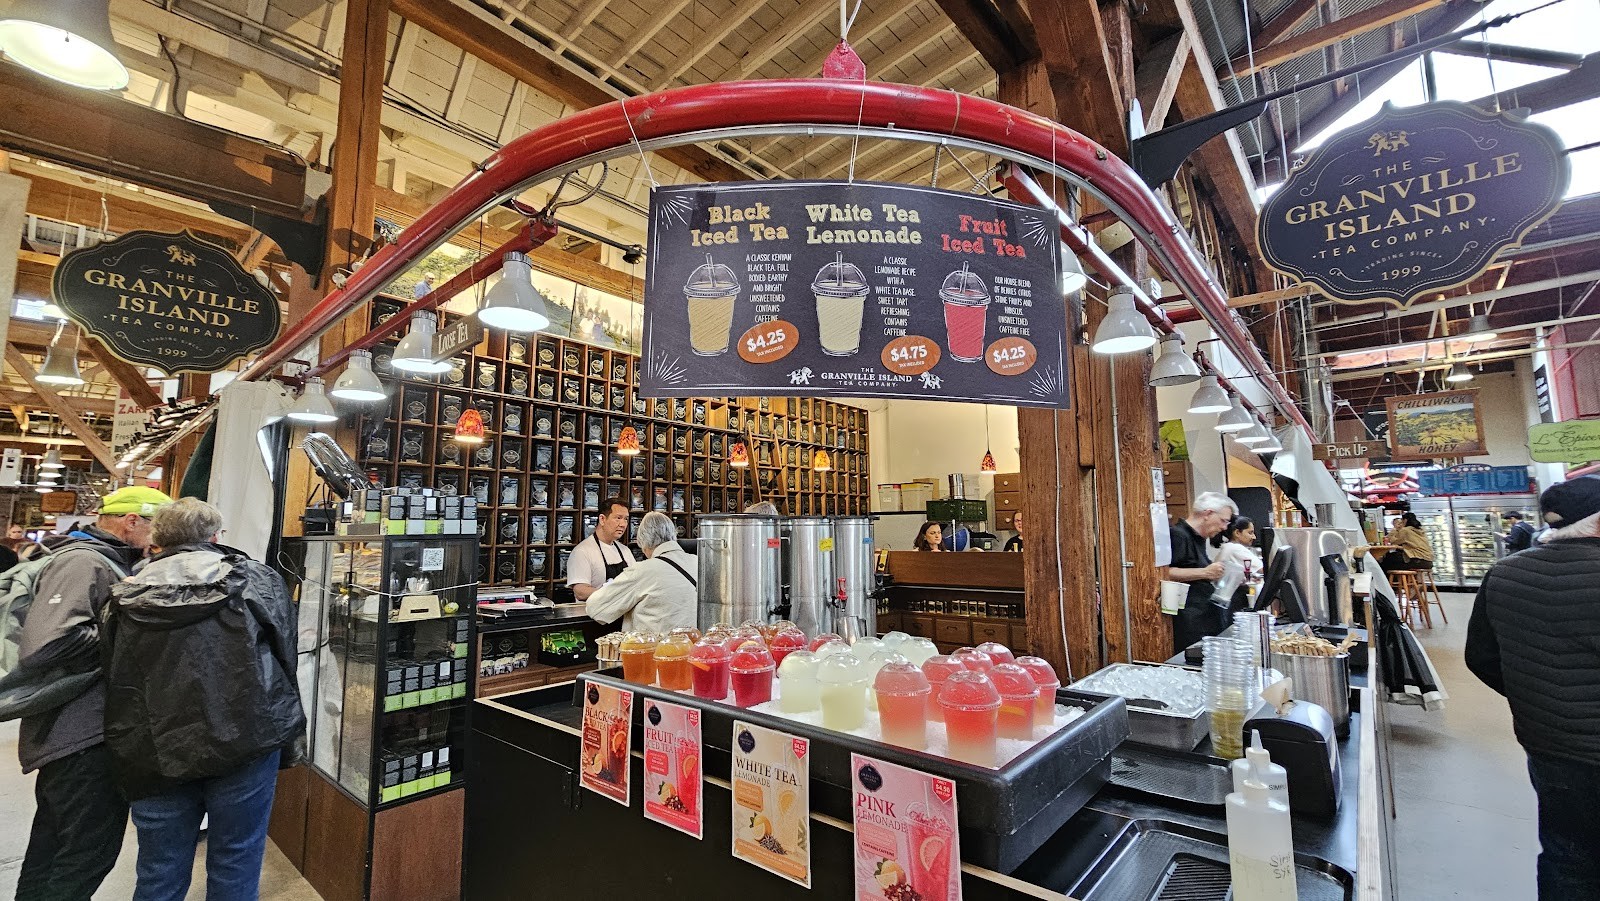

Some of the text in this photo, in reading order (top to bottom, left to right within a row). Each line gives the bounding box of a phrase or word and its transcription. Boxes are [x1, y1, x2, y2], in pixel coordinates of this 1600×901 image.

[1373, 160, 1413, 178] THE
[1285, 152, 1523, 226] GRANVILLE
[708, 202, 771, 225] Black
[805, 204, 921, 223] White Tea
[1325, 193, 1476, 243] ISLAND
[959, 214, 1008, 237] Fruit
[691, 223, 789, 247] Iced Tea
[806, 226, 922, 244] Lemonade
[1318, 217, 1486, 260] TEA COMPANY
[941, 234, 1027, 258] Iced Tea
[751, 254, 770, 262] CLASSIC
[772, 254, 792, 262] KENYAN
[883, 256, 907, 265] A CLASSIC
[165, 271, 195, 283] THE
[874, 266, 916, 276] LEMONADE RECIPE
[1381, 265, 1421, 282] 1999
[875, 286, 891, 294] WHITE
[892, 287, 902, 295] TEA
[995, 276, 1031, 288] OUR HOUSE BLEND
[84, 269, 260, 315] GRANVILLE
[750, 294, 786, 302] UNSWEETENED
[878, 297, 894, 305] SWEET
[995, 296, 1033, 307] STONE FRUITS AND
[118, 295, 230, 328] ISLAND
[881, 307, 910, 316] REFRESHING
[110, 314, 234, 340] TEA COMPANY
[884, 318, 908, 326] CONTAINS
[998, 316, 1028, 326] UNSWEETENED
[999, 325, 1030, 336] CAFFEINE FREE
[747, 329, 786, 352] $4.25
[158, 347, 187, 358] 1999
[890, 345, 928, 362] $4.75
[993, 346, 1026, 363] $4.25
[821, 372, 912, 382] GRANVILLE ISLAND
[1397, 395, 1466, 409] CHILLIWACK
[1419, 443, 1458, 454] HONEY
[586, 706, 608, 722] BLACK
[646, 727, 674, 744] FRUIT
[662, 744, 674, 753] TEA
[734, 770, 771, 788] LEMONADE
[736, 756, 798, 787] WHITE TEA
[857, 792, 897, 818] PINK
[857, 808, 908, 833] LEMONADE
